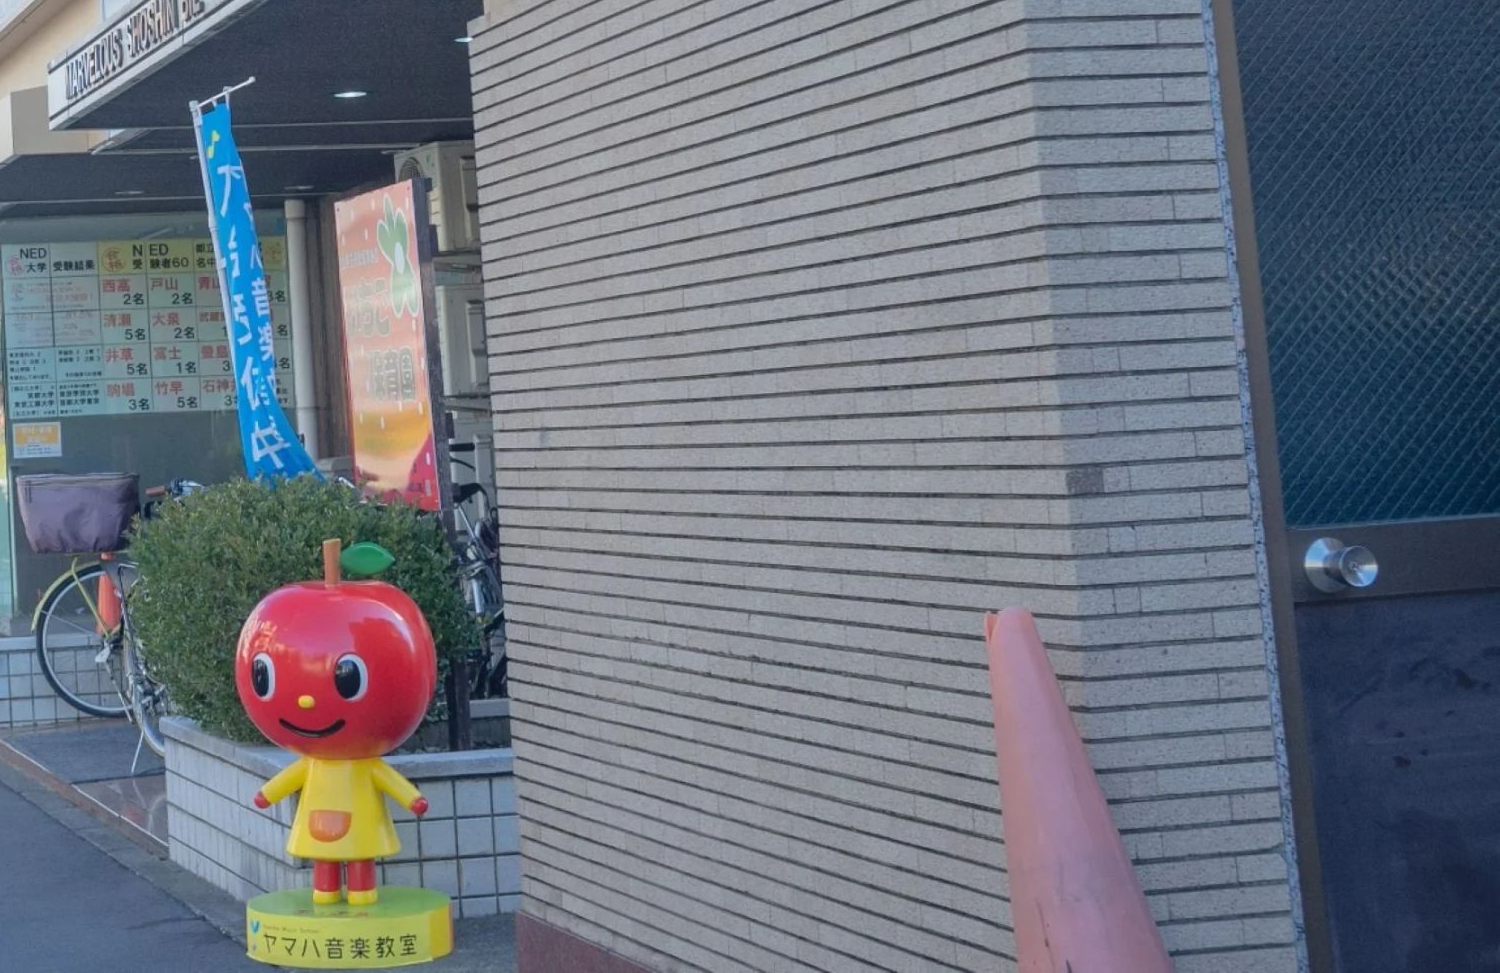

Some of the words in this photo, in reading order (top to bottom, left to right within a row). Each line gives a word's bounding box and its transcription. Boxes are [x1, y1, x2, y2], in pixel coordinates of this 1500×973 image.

[19, 247, 48, 259] NED
[123, 293, 145, 305] 2名
[171, 292, 194, 305] 2名
[124, 328, 146, 341] 5名
[174, 327, 195, 339] 2名
[126, 363, 148, 376] 5名
[175, 361, 197, 374] 1名
[128, 399, 150, 411] 3名
[176, 396, 198, 409] 5名
[263, 932, 418, 960] ヤマハ音楽教室
